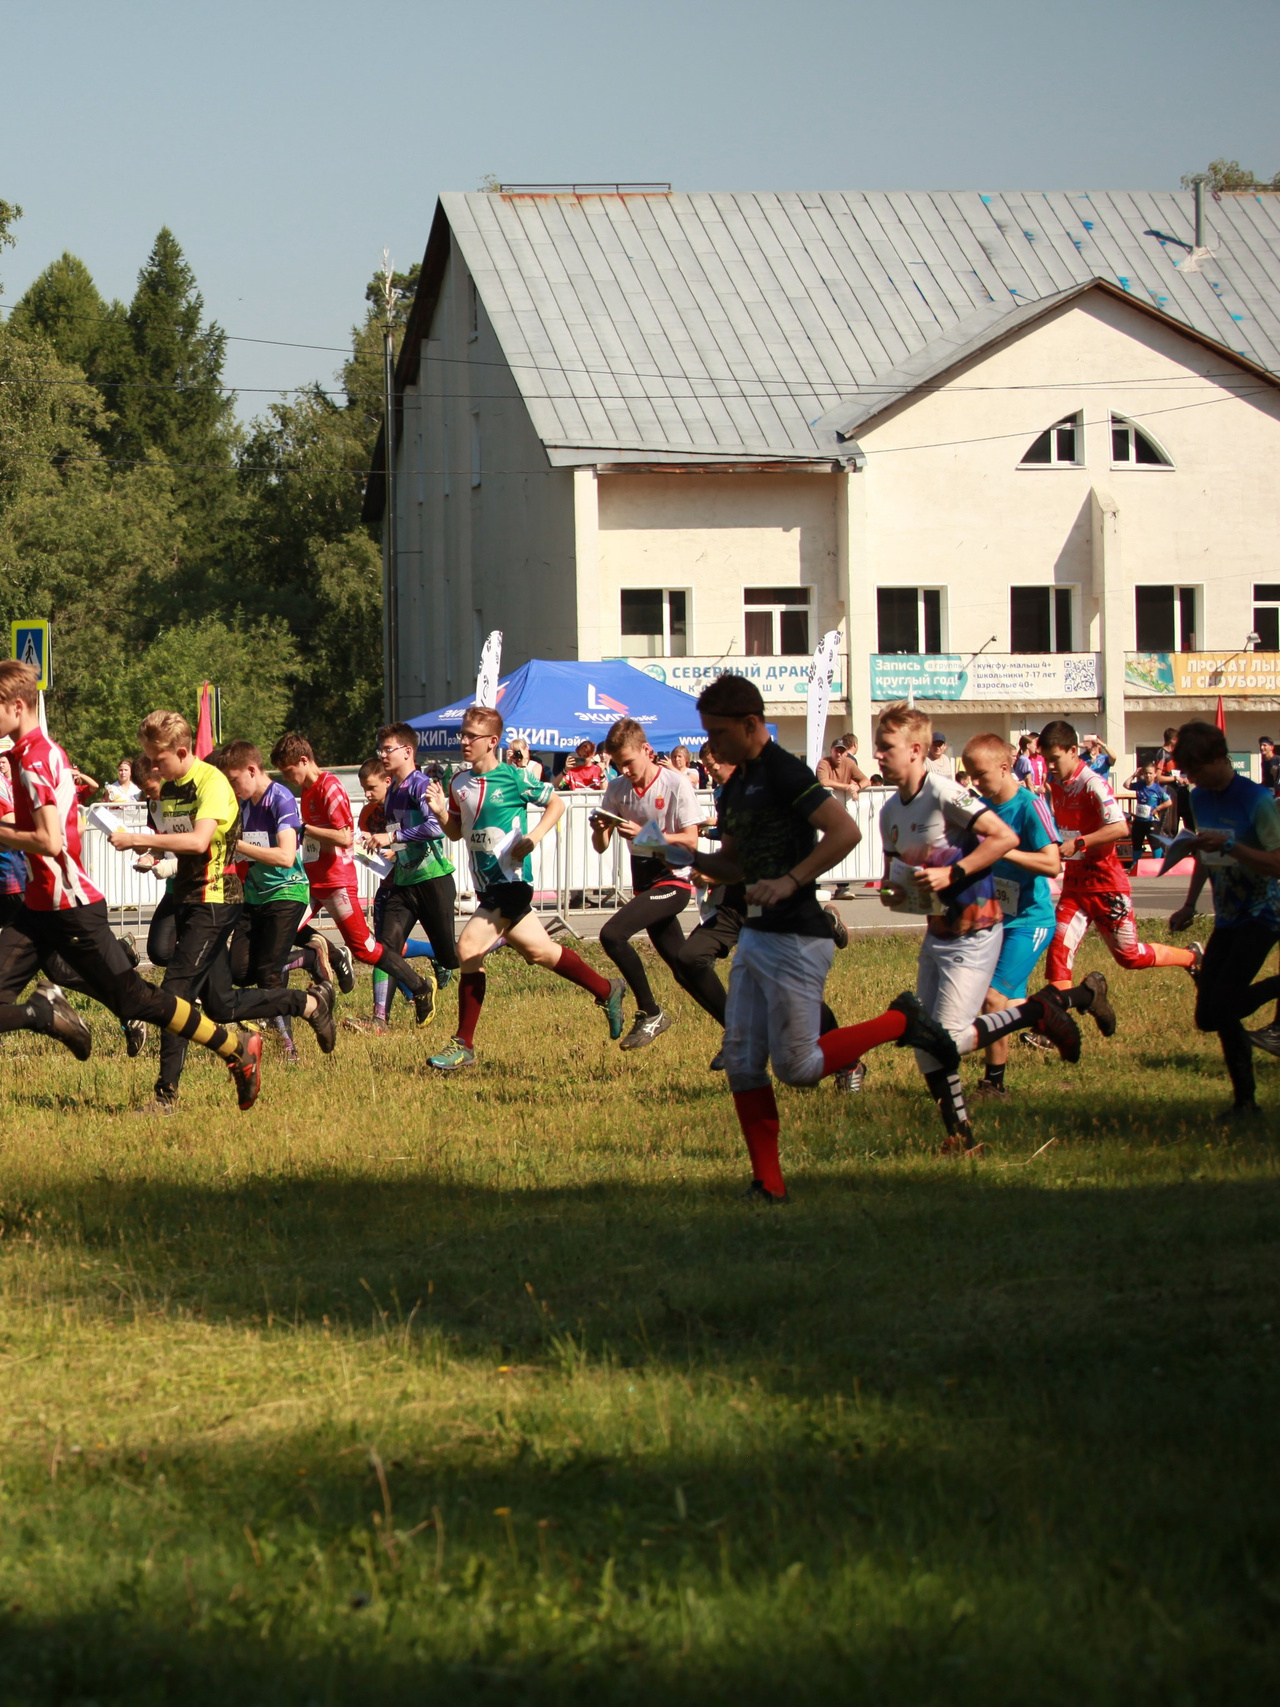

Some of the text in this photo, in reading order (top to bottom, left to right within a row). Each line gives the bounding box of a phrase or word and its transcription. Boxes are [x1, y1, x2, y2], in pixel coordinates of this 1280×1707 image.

[672, 662, 811, 680] СЕВЕРНЫЙ ДРАК
[875, 659, 921, 672] Запись
[1188, 660, 1246, 673] ПРОКАТ
[875, 672, 960, 689] круглый год!
[976, 672, 1023, 680] школьники
[1025, 671, 1041, 679] 7-17
[1181, 676, 1192, 689] И
